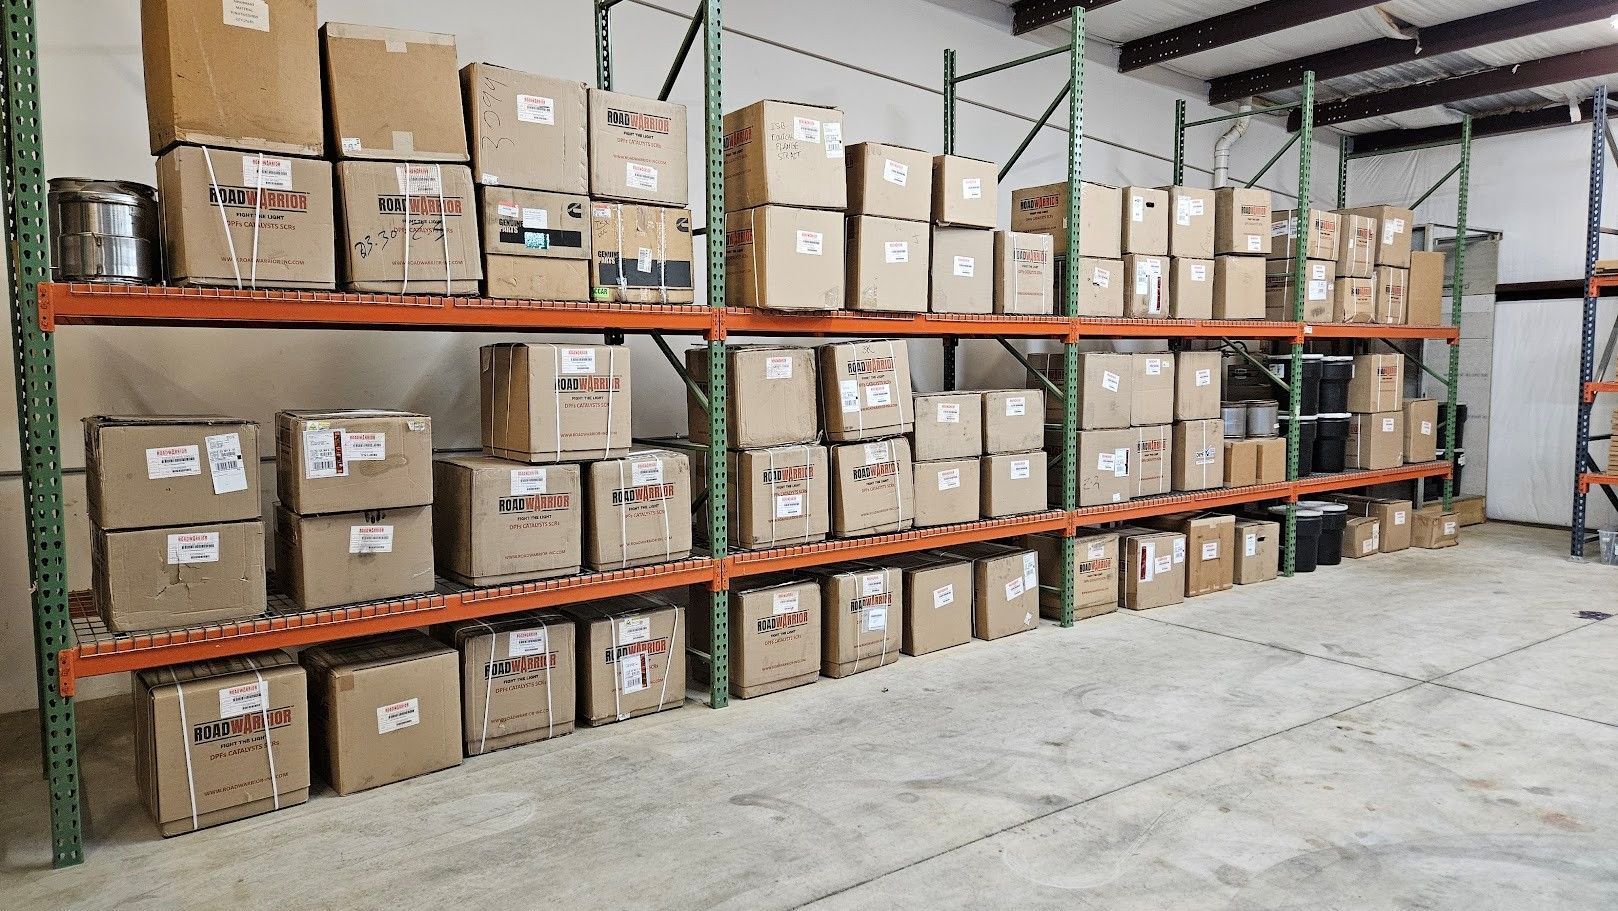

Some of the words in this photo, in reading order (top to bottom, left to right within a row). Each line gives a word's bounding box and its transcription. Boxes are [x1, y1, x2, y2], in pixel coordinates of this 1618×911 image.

[607, 110, 669, 132] ROADWARRIOR
[209, 187, 307, 210] ROADWARRIOR
[499, 218, 524, 227] GENUINE
[597, 250, 620, 258] GENUIN
[847, 358, 895, 374] ROADWARRIO
[763, 467, 814, 482] ROADWARRIOR
[853, 462, 900, 480] ROADWARRIOR
[498, 493, 570, 513] ROADWARRIOR
[612, 485, 674, 504] ROADWARRIOR
[850, 594, 892, 612] ROADWARRIR
[757, 611, 808, 632] ROADWARRIOR
[484, 654, 557, 678] ROADWARRIOR
[193, 709, 292, 743] ROADWARRIOR
[220, 741, 237, 749] FIGHT
[228, 743, 263, 757] CATALYSTS
[263, 740, 280, 749] SRs
